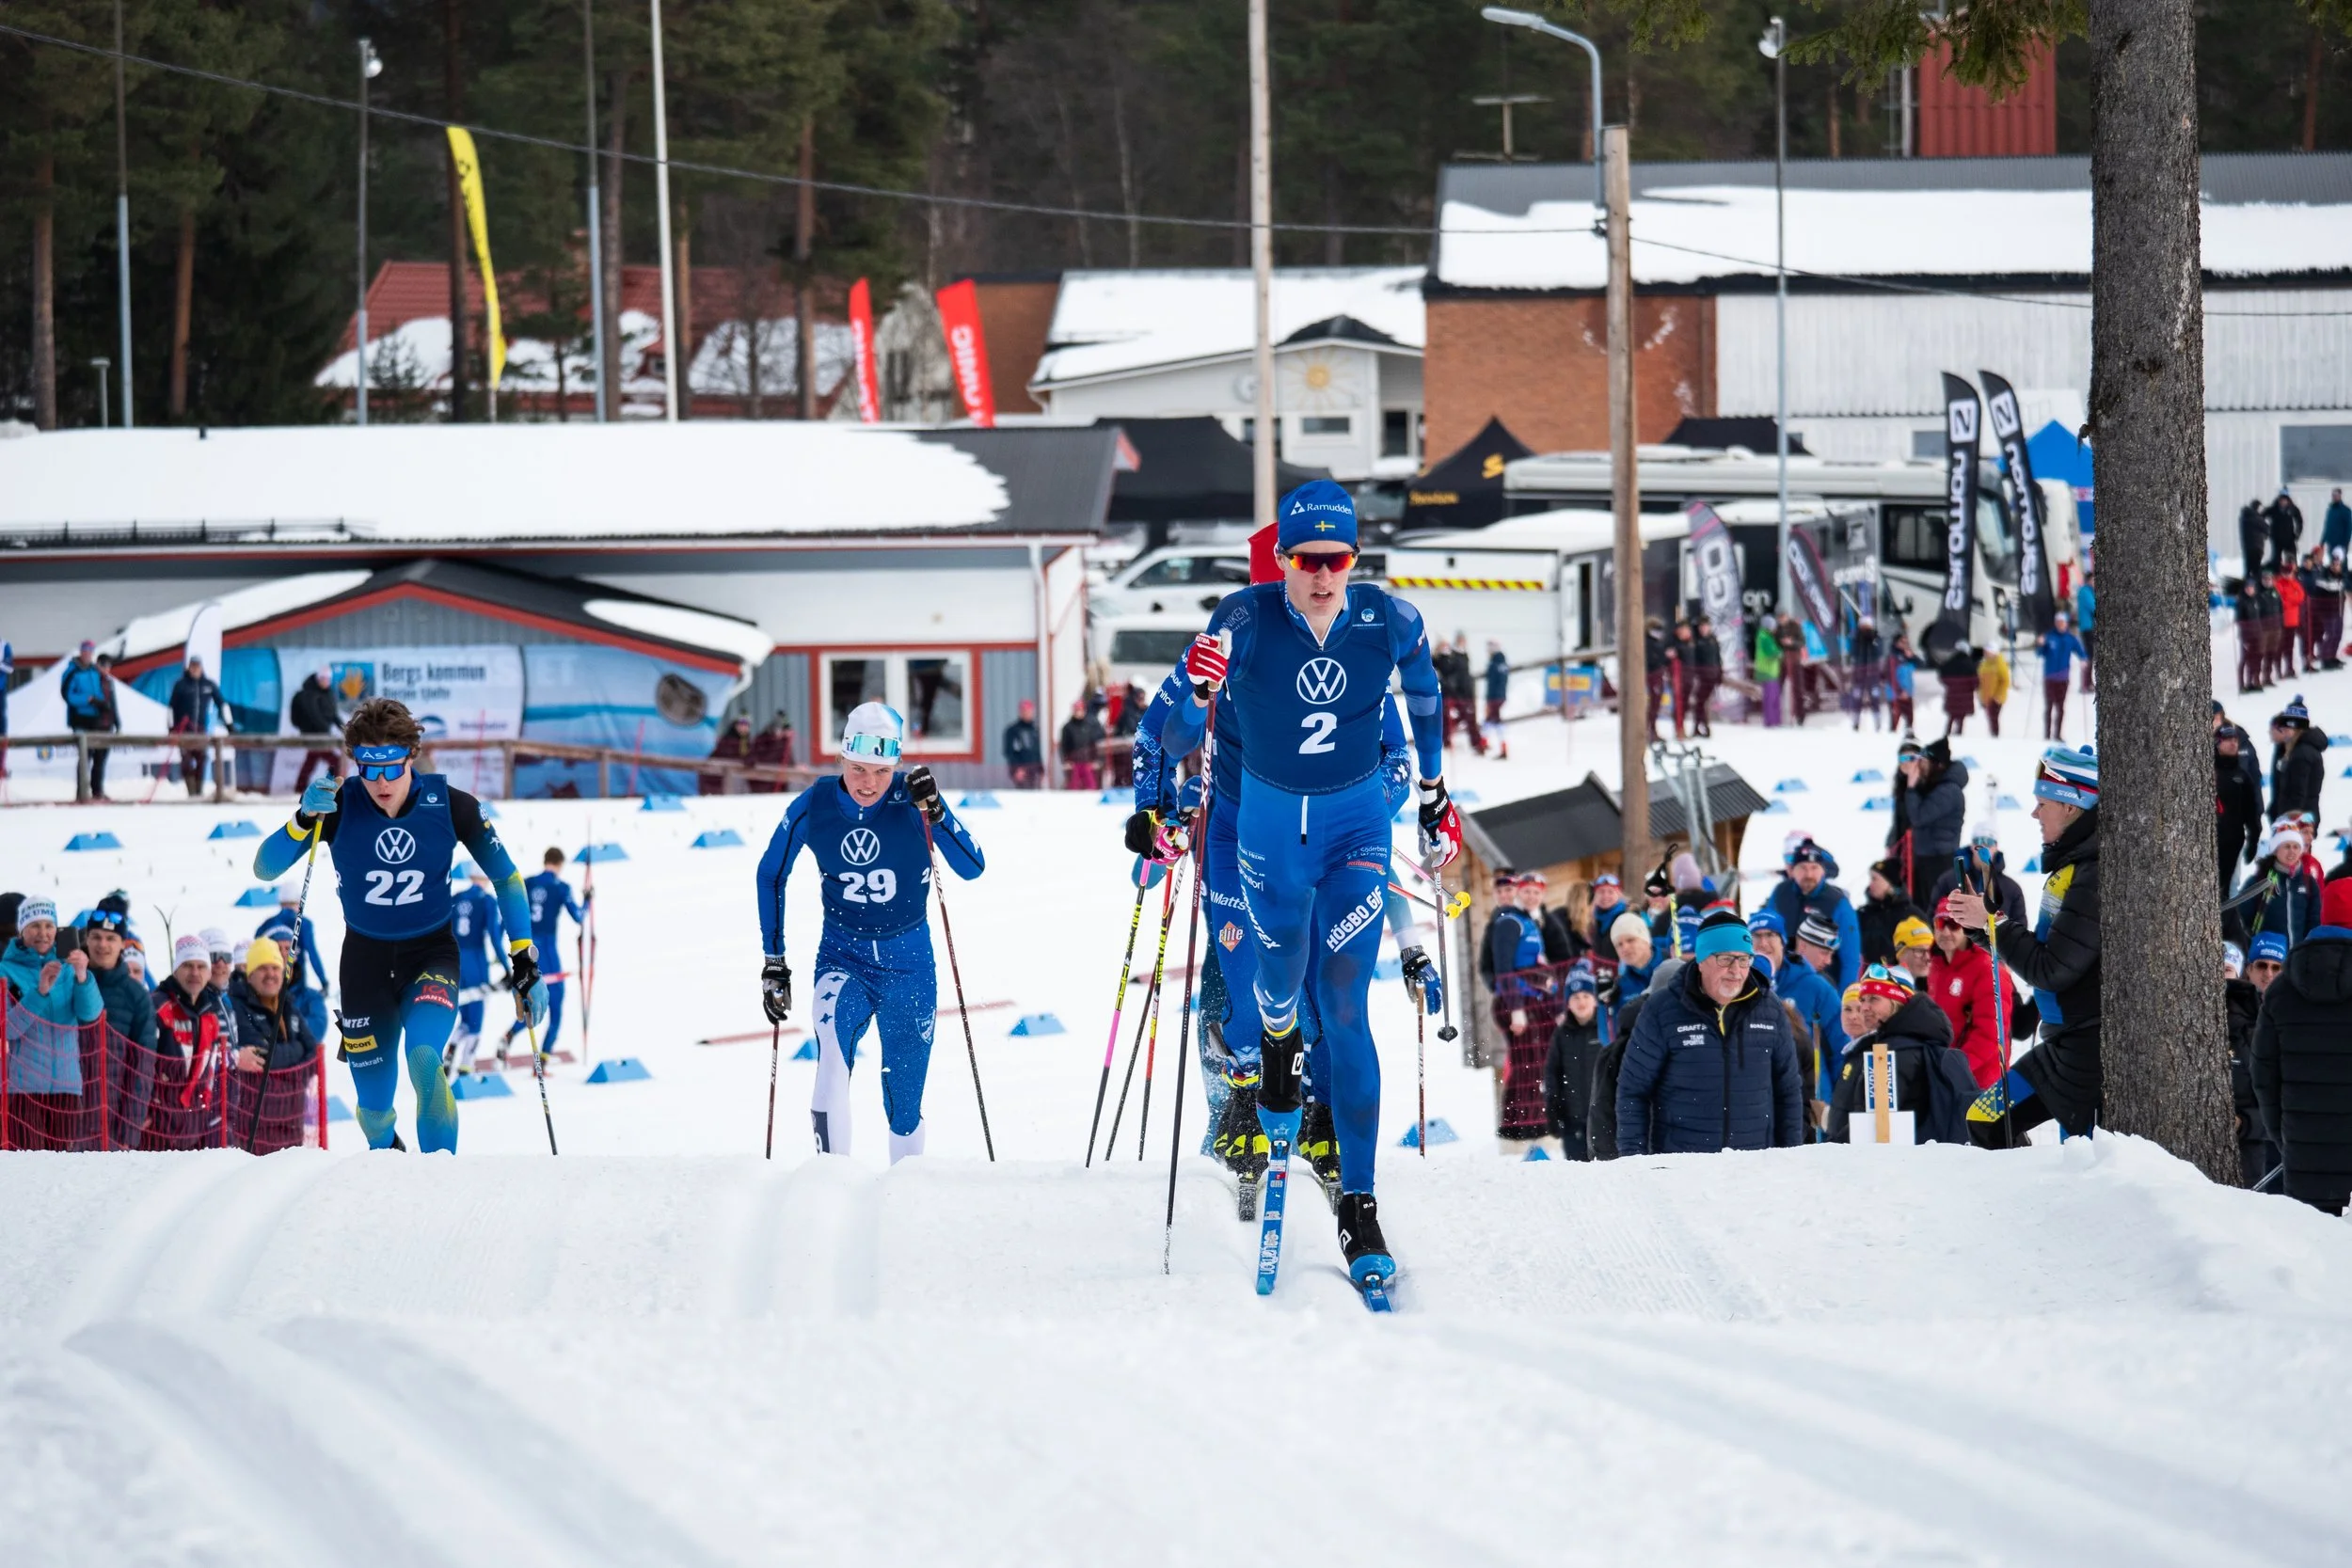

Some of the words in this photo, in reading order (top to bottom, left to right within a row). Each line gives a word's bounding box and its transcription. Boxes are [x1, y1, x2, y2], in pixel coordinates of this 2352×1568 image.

[1307, 503, 1353, 515] Ramudden
[382, 662, 421, 683] Bergs
[427, 661, 485, 681] kommun
[1298, 712, 1337, 754] 2
[365, 870, 426, 906] 22
[838, 868, 898, 904] 29
[1326, 905, 1369, 950] HÖGBO
[1366, 884, 1383, 911] GIF
[1677, 1023, 1701, 1033] CRAFT
